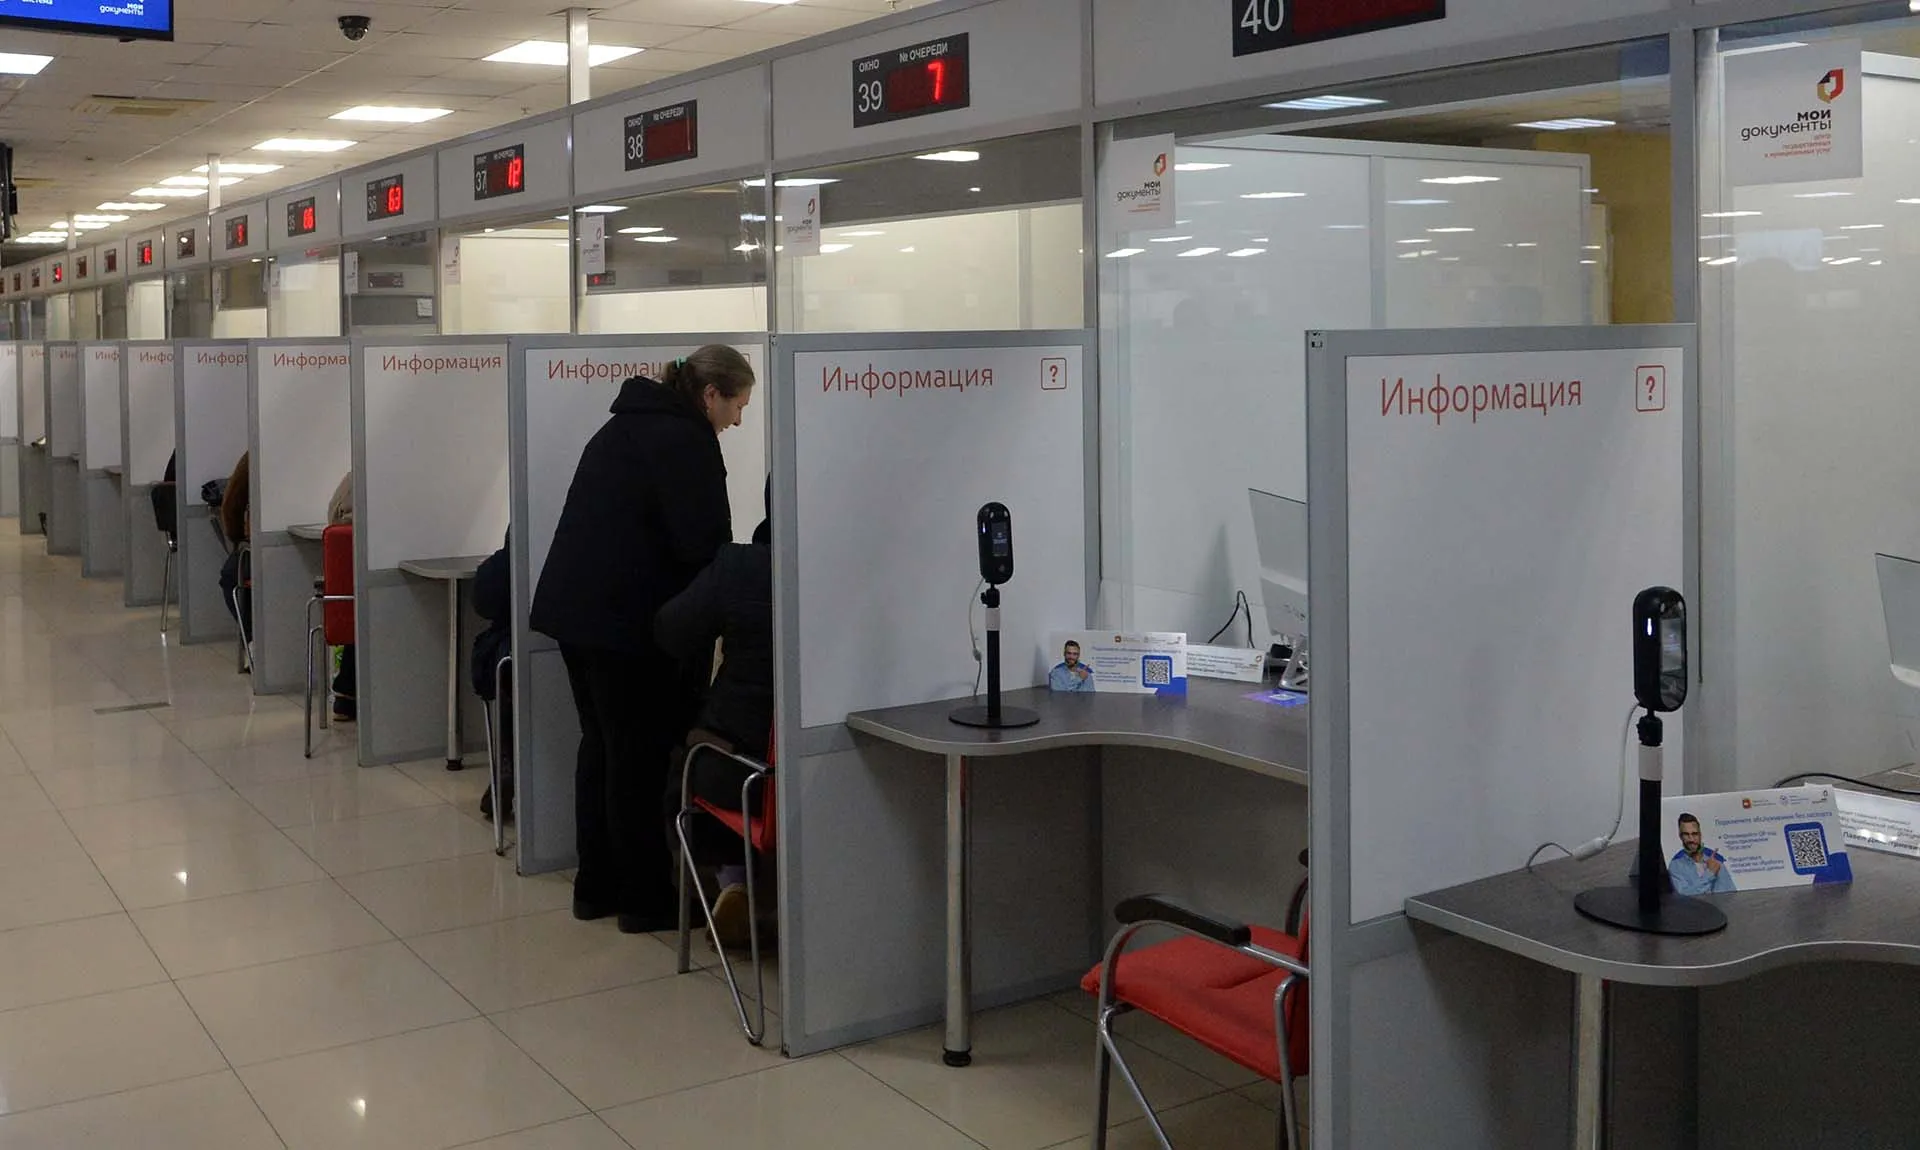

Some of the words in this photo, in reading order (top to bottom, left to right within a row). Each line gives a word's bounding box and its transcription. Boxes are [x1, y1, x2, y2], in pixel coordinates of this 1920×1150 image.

[1240, 0, 1284, 35] 40
[859, 59, 880, 73] ОКНО
[899, 52, 908, 63] №
[909, 42, 948, 60] ОЧЕРЕДИ
[927, 60, 944, 100] 7
[858, 80, 882, 113] 39
[1797, 109, 1831, 121] мои
[1741, 120, 1832, 141] документы
[627, 134, 644, 160] 38
[475, 170, 487, 192] 37
[1116, 189, 1161, 201] документы
[273, 352, 350, 371] Информа
[383, 353, 502, 375] Информация
[822, 363, 993, 398] Информация
[1380, 374, 1583, 425] Информация
